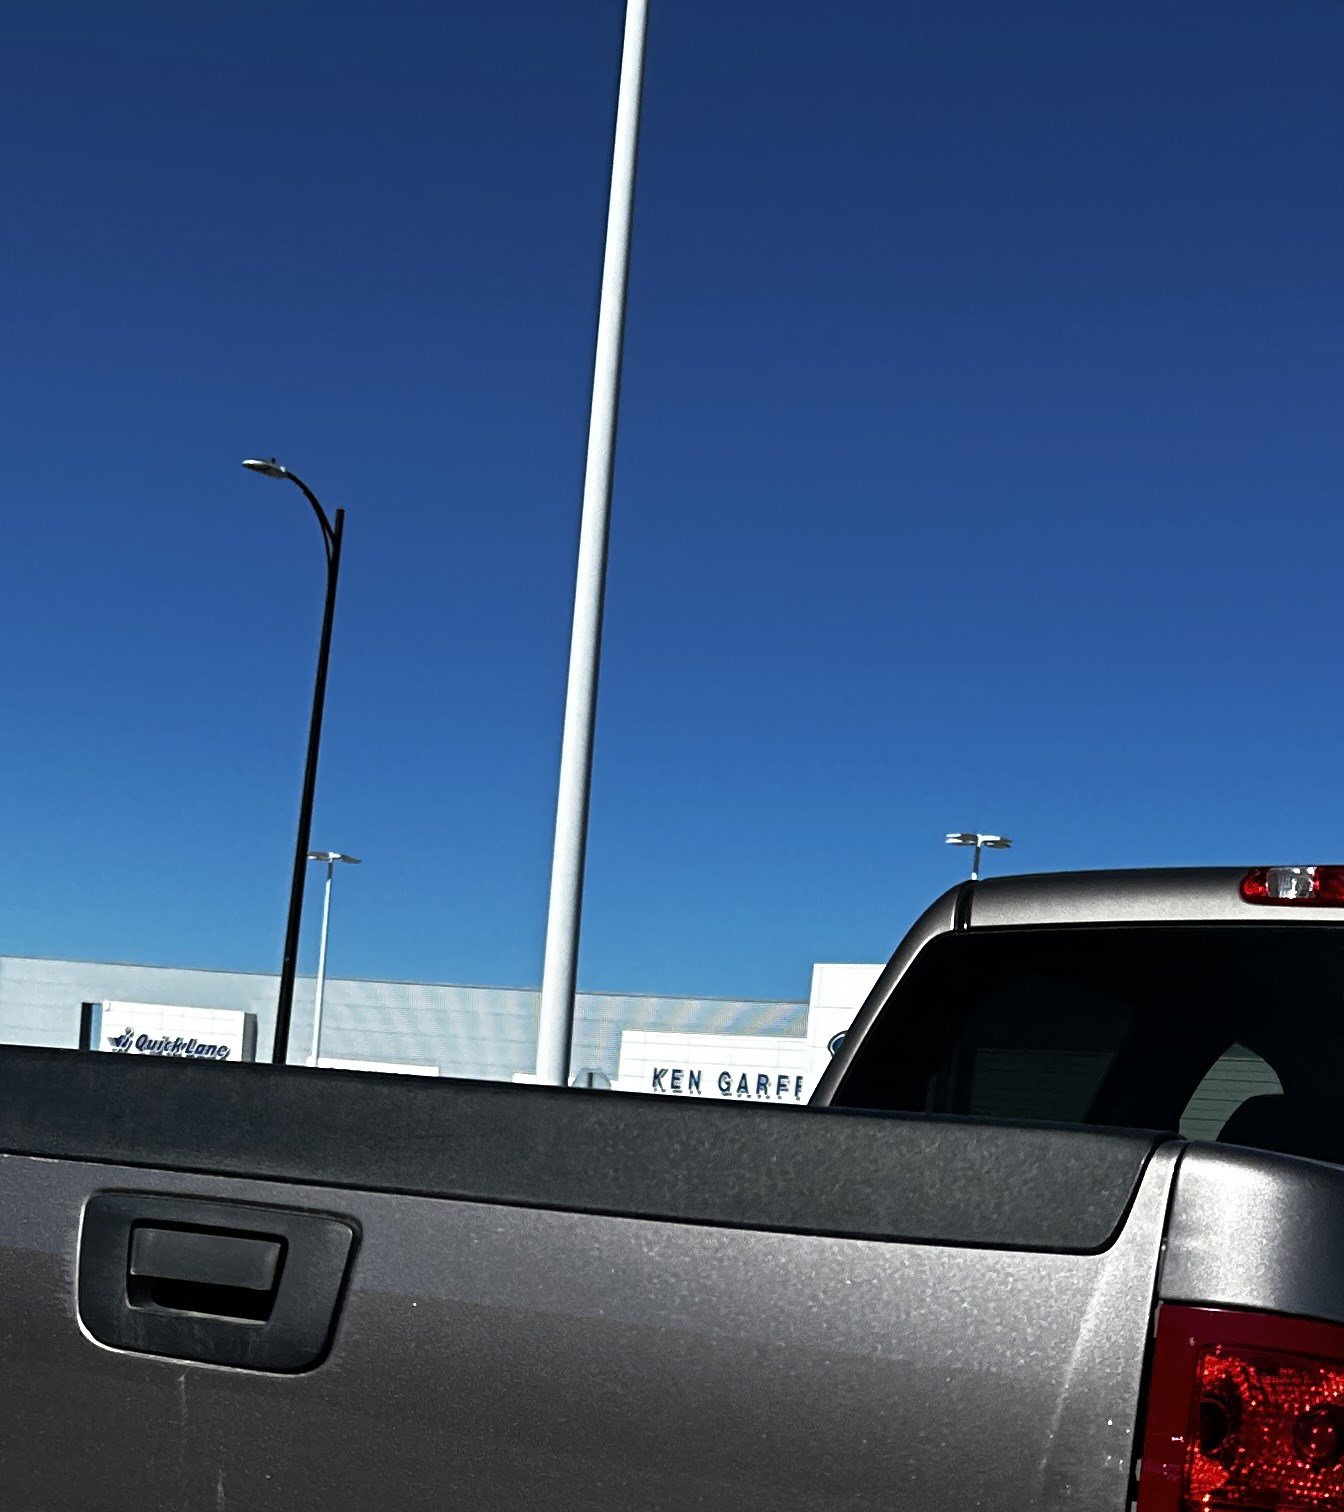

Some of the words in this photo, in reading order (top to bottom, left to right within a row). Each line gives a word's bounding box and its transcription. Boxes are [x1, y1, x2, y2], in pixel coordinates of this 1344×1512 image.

[135, 1033, 187, 1053] Quick
[184, 1038, 231, 1058] Lane
[652, 1067, 701, 1094] KEN
